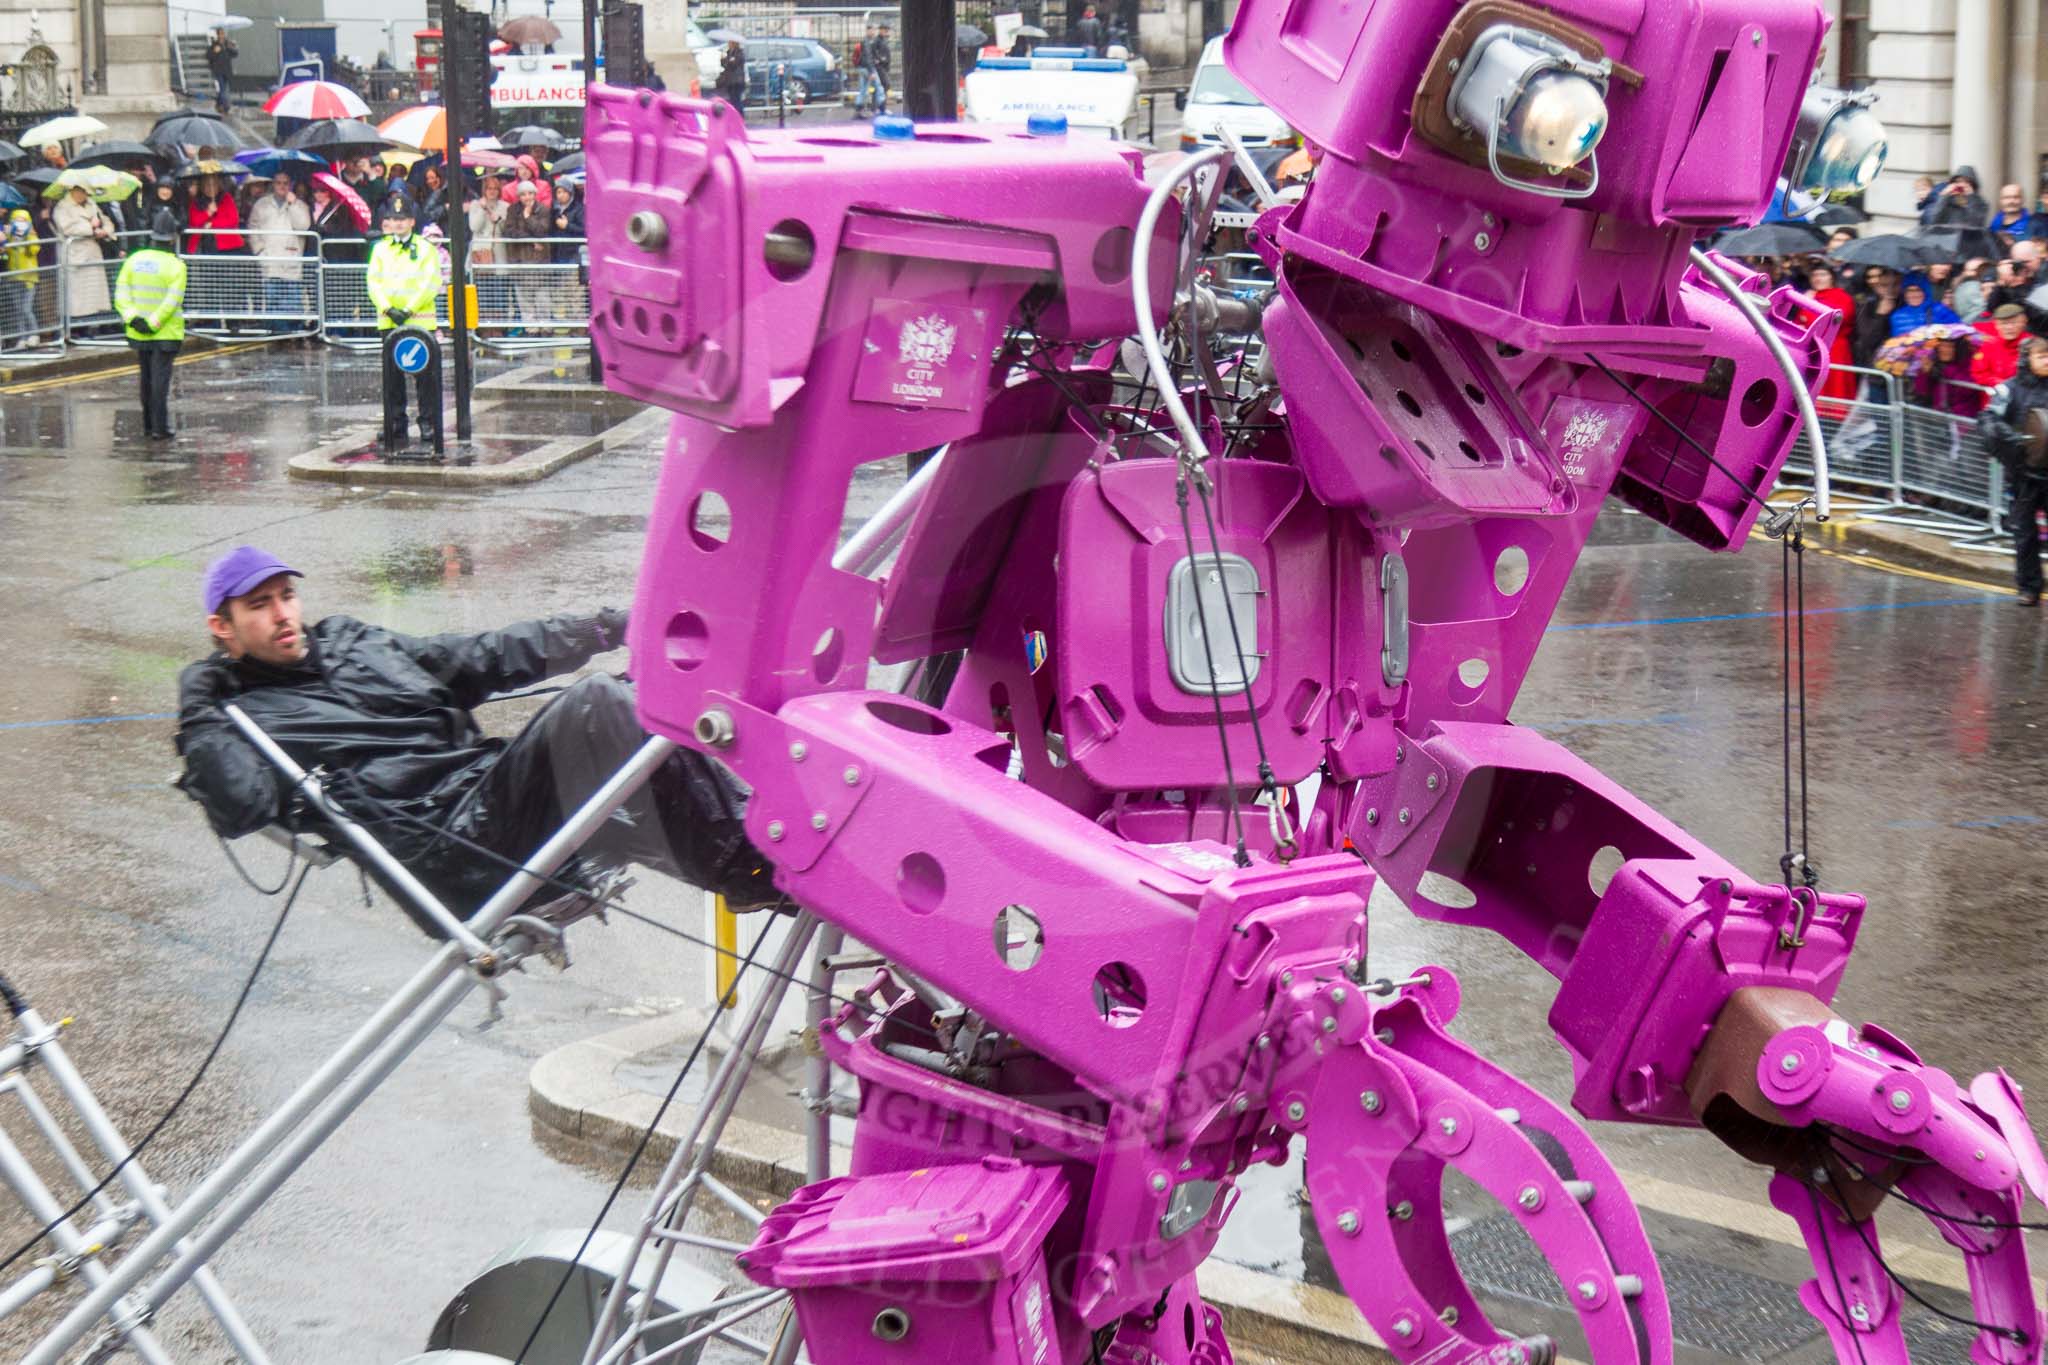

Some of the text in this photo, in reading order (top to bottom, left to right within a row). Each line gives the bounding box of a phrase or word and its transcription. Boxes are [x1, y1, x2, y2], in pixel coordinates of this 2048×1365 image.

[490, 88, 586, 100] MBULANCE
[1002, 103, 1096, 112] AMBULANCE
[906, 370, 935, 380] CITY
[892, 383, 943, 398] LONDON
[1563, 453, 1583, 462] CITY
